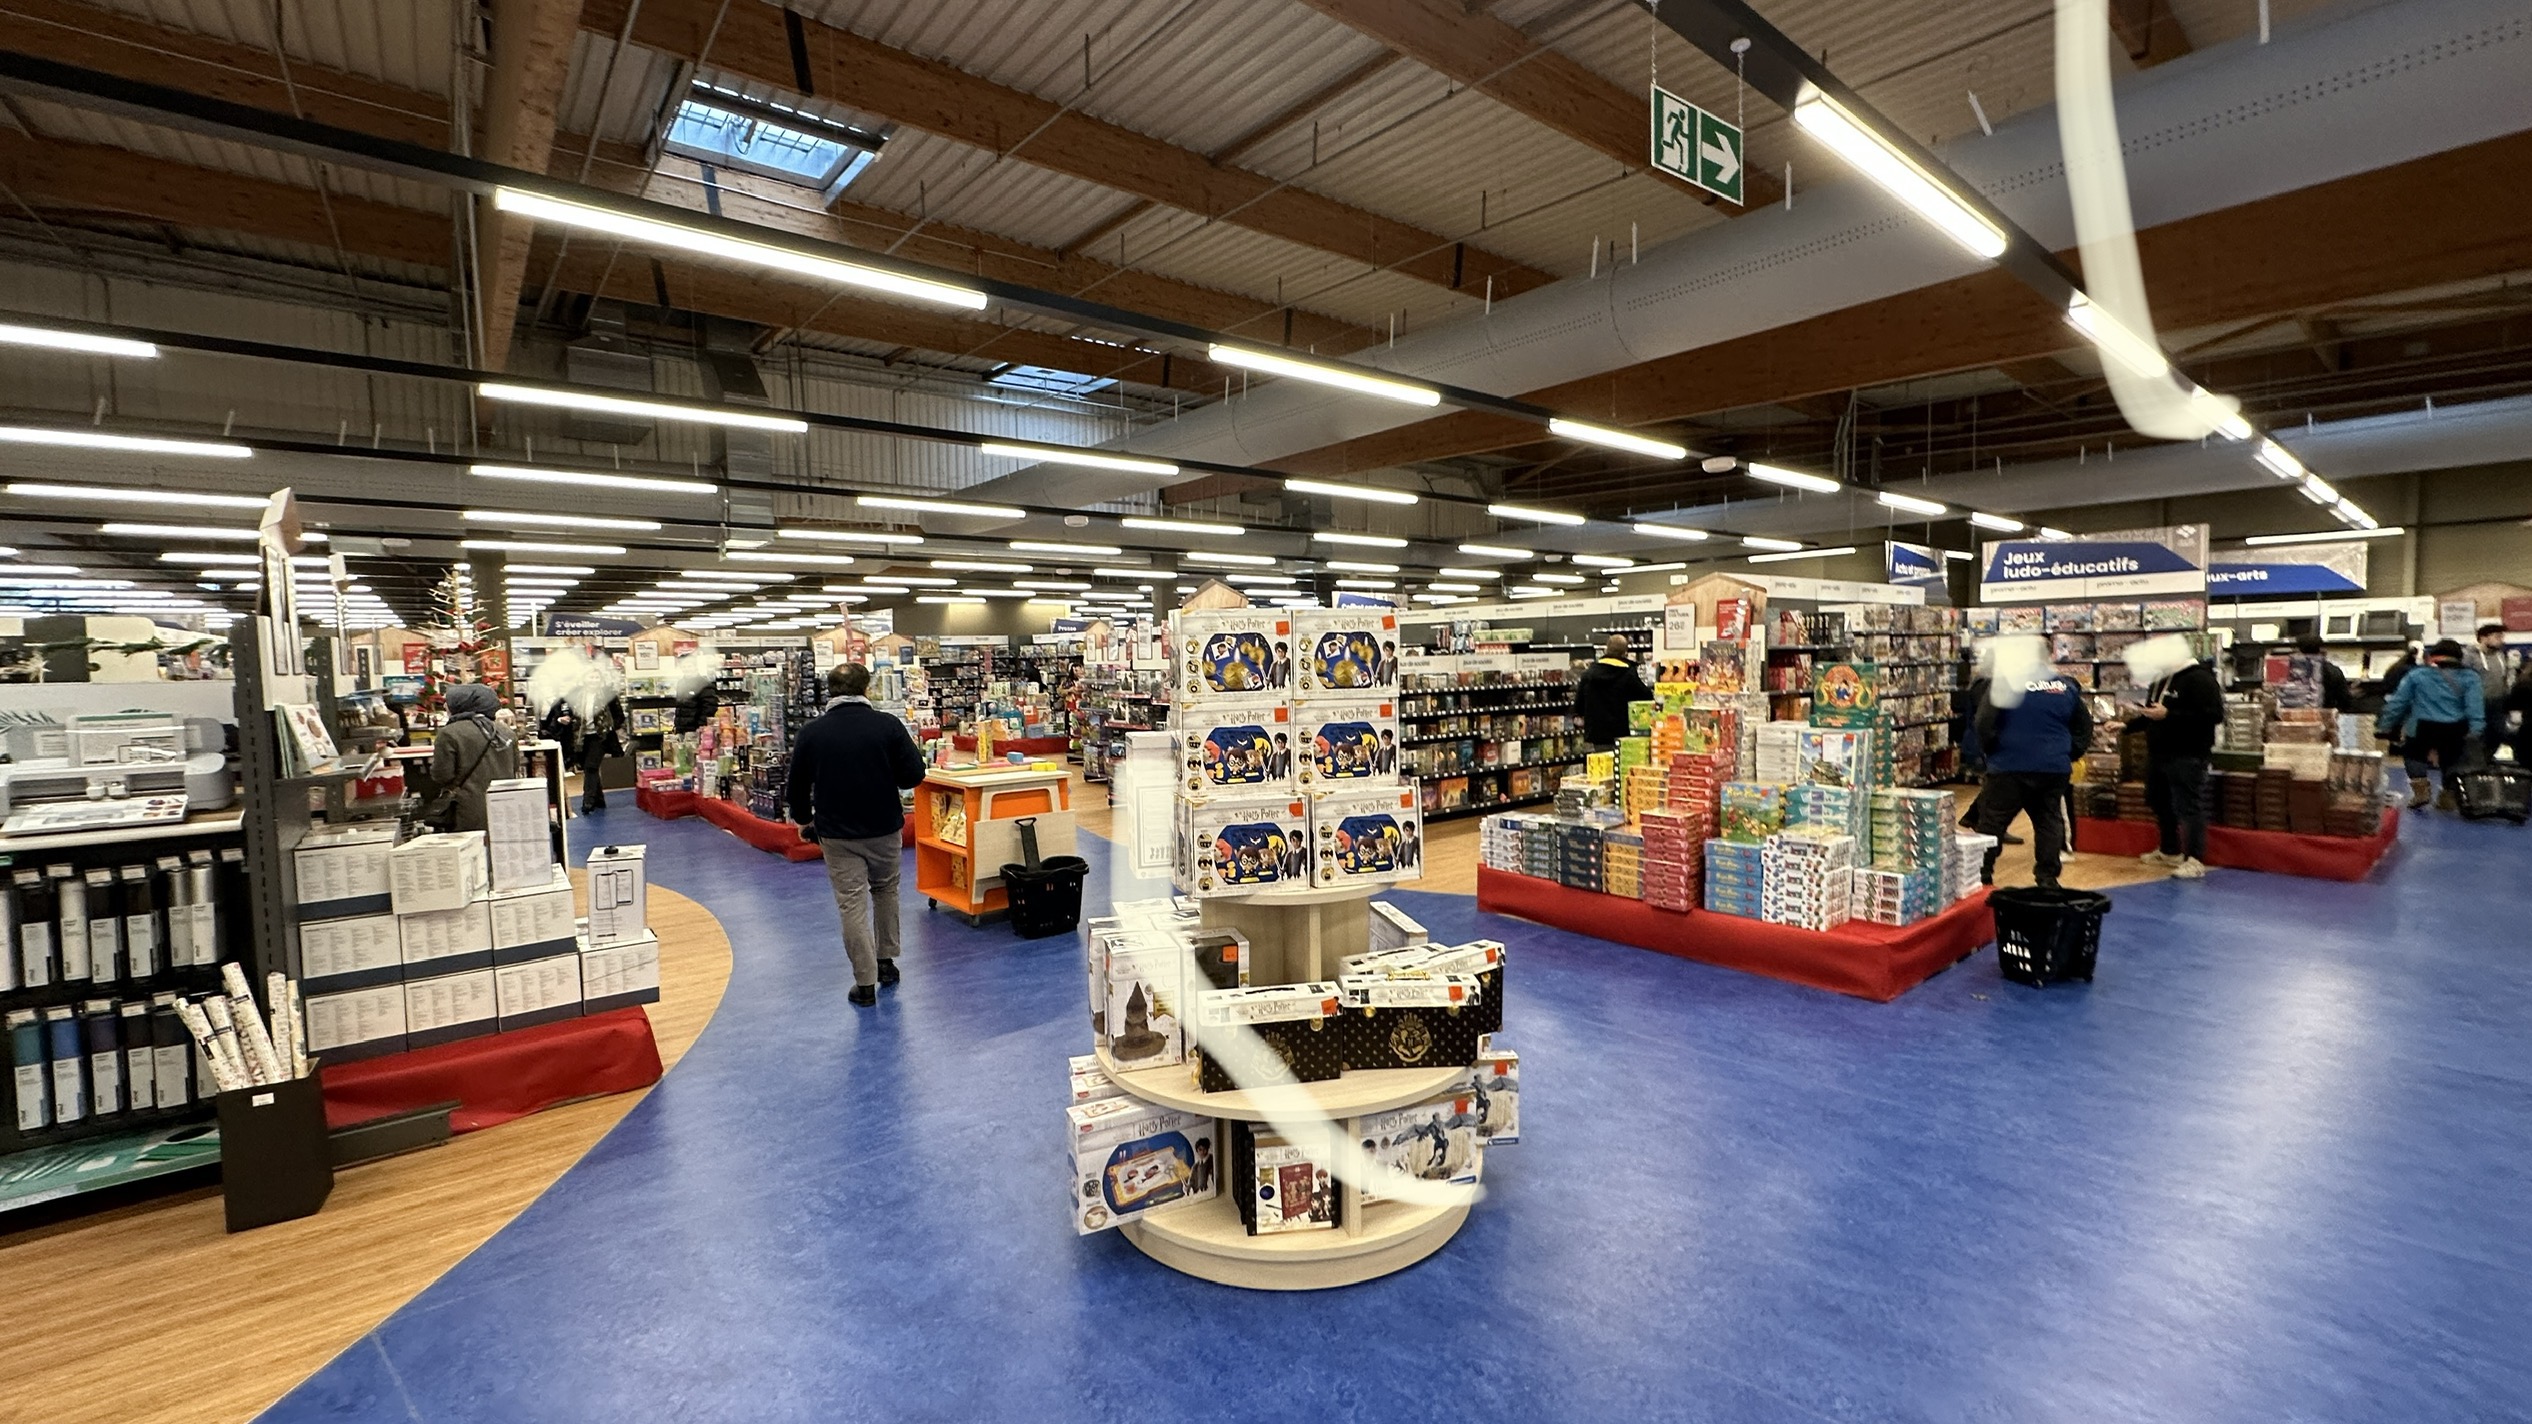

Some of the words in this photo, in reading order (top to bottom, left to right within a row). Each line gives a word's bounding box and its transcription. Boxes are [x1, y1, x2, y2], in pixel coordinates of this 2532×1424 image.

[2003, 552, 2045, 566] Jeux
[2003, 557, 2139, 579] ludo-éducatifs
[2206, 570, 2268, 583] ux-arts
[555, 620, 600, 628] S'éveiller
[555, 628, 582, 636] créer
[582, 629, 623, 638] explorer
